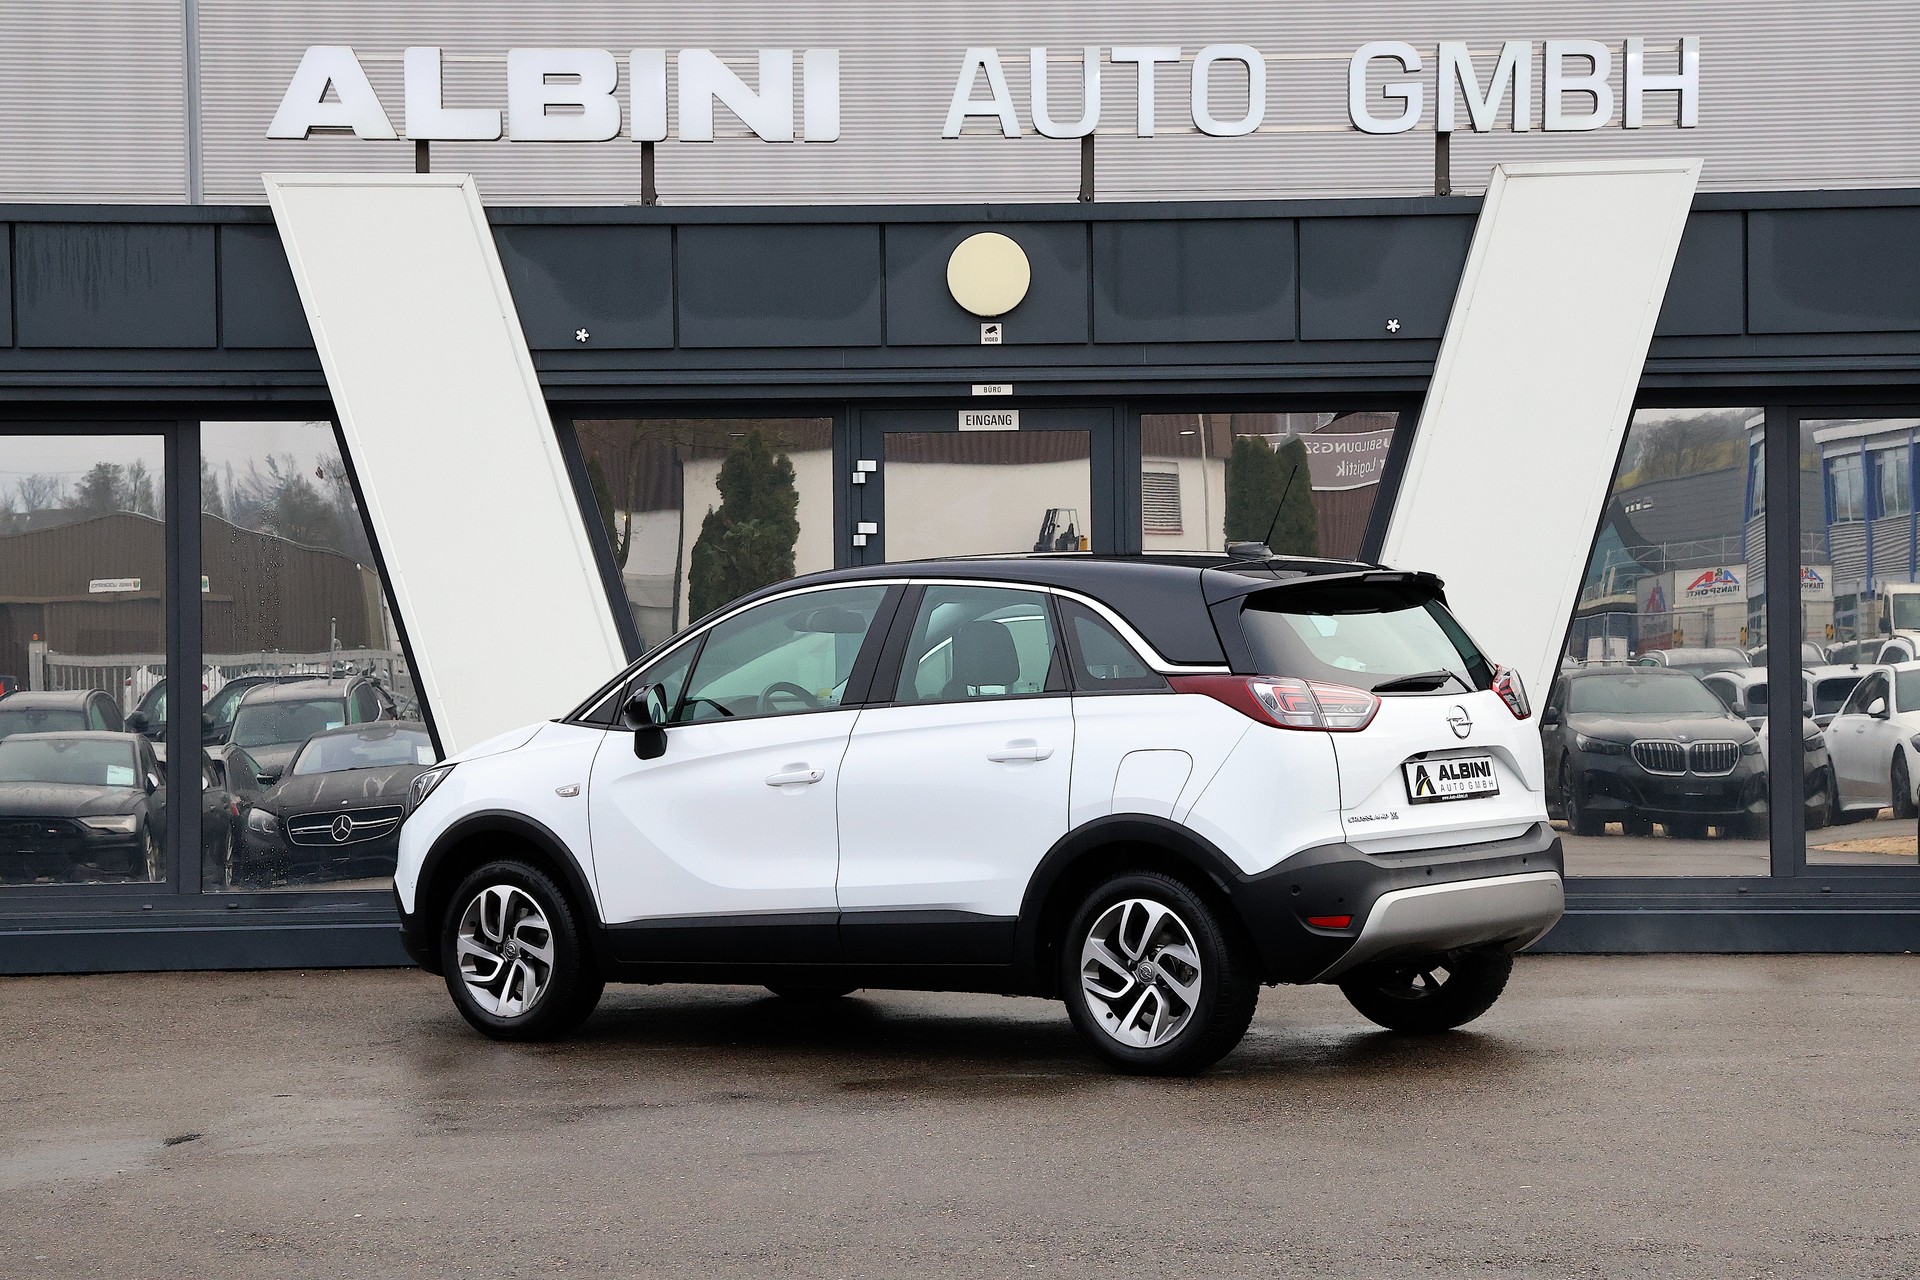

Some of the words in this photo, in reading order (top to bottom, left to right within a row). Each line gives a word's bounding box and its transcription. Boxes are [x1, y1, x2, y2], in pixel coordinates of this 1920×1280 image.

[265, 45, 841, 143] ALBINI
[941, 43, 1267, 140] AUTO
[1347, 36, 1701, 134] GMBH
[983, 385, 1002, 394] BÜRO
[966, 414, 1012, 426] EINGANG
[1439, 761, 1491, 781] ALBINI
[1440, 782, 1465, 793] AUTO
[1468, 780, 1494, 790] GMBH
